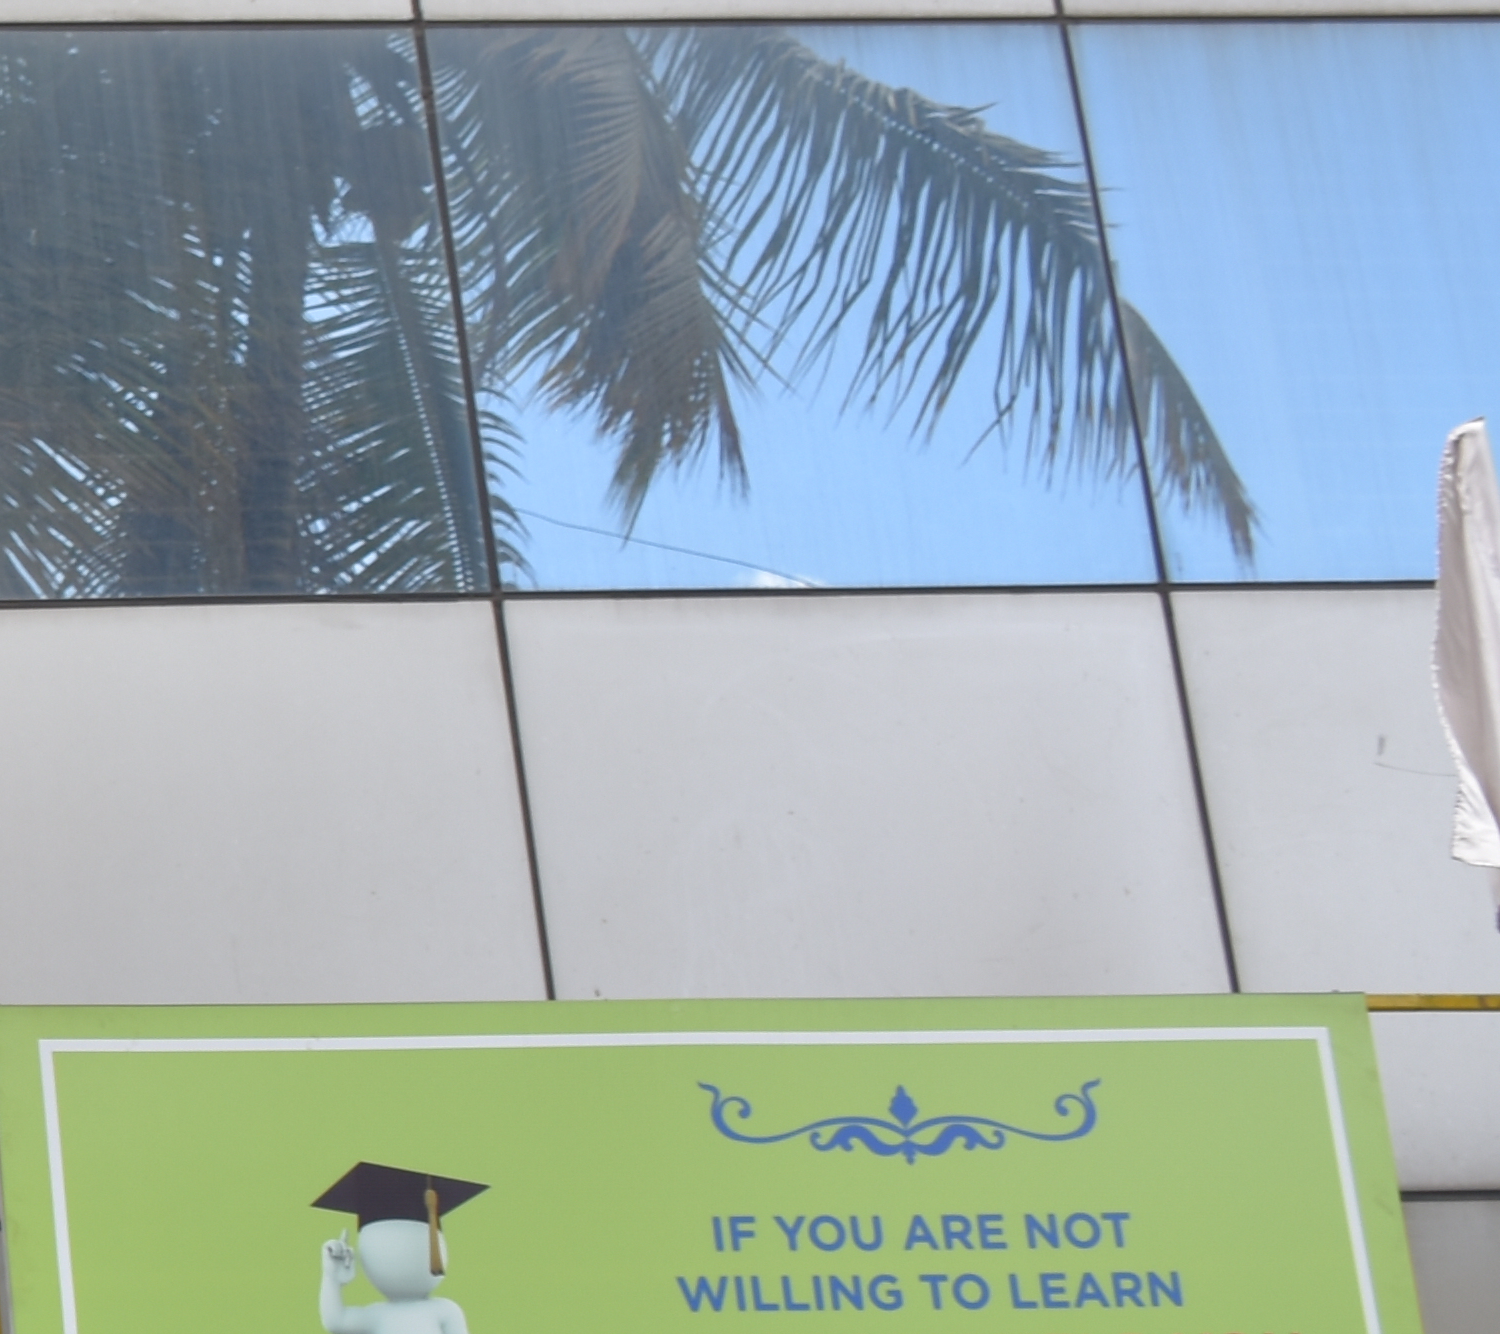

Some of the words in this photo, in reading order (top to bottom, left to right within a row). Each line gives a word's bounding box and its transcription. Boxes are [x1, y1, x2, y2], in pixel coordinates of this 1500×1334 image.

[711, 1215, 758, 1253] IF
[773, 1214, 884, 1253] YOU
[902, 1213, 1006, 1252] ARE
[1023, 1211, 1131, 1250] NOT
[675, 1273, 905, 1313] WILLING
[918, 1273, 991, 1311] TO
[1009, 1270, 1185, 1310] LEARN
